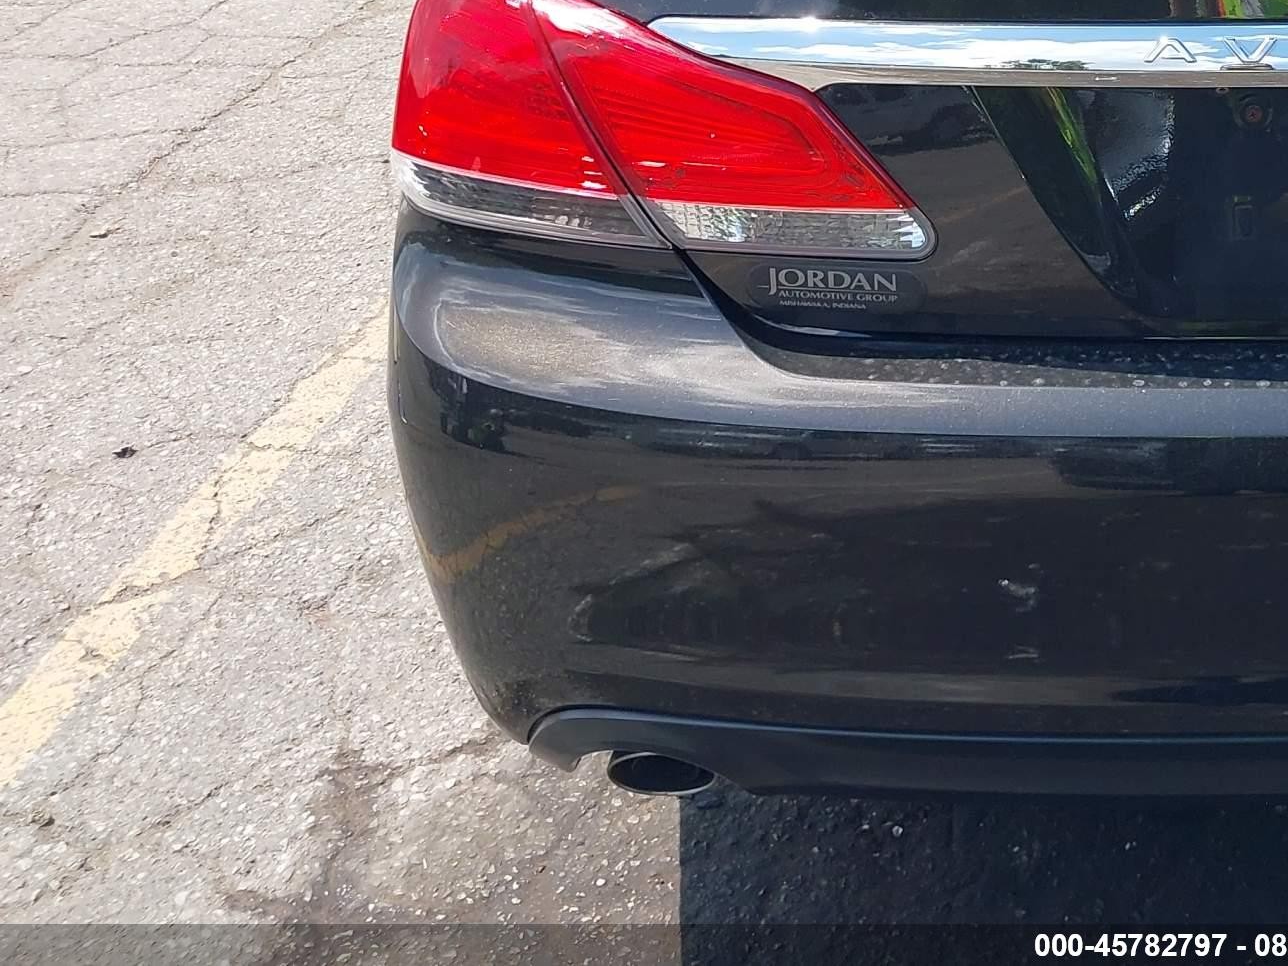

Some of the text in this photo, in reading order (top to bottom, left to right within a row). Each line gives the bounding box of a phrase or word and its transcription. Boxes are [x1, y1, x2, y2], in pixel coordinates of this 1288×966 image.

[769, 267, 897, 295] JORDAN
[779, 290, 898, 303] AUTOMOTIVE GROUP
